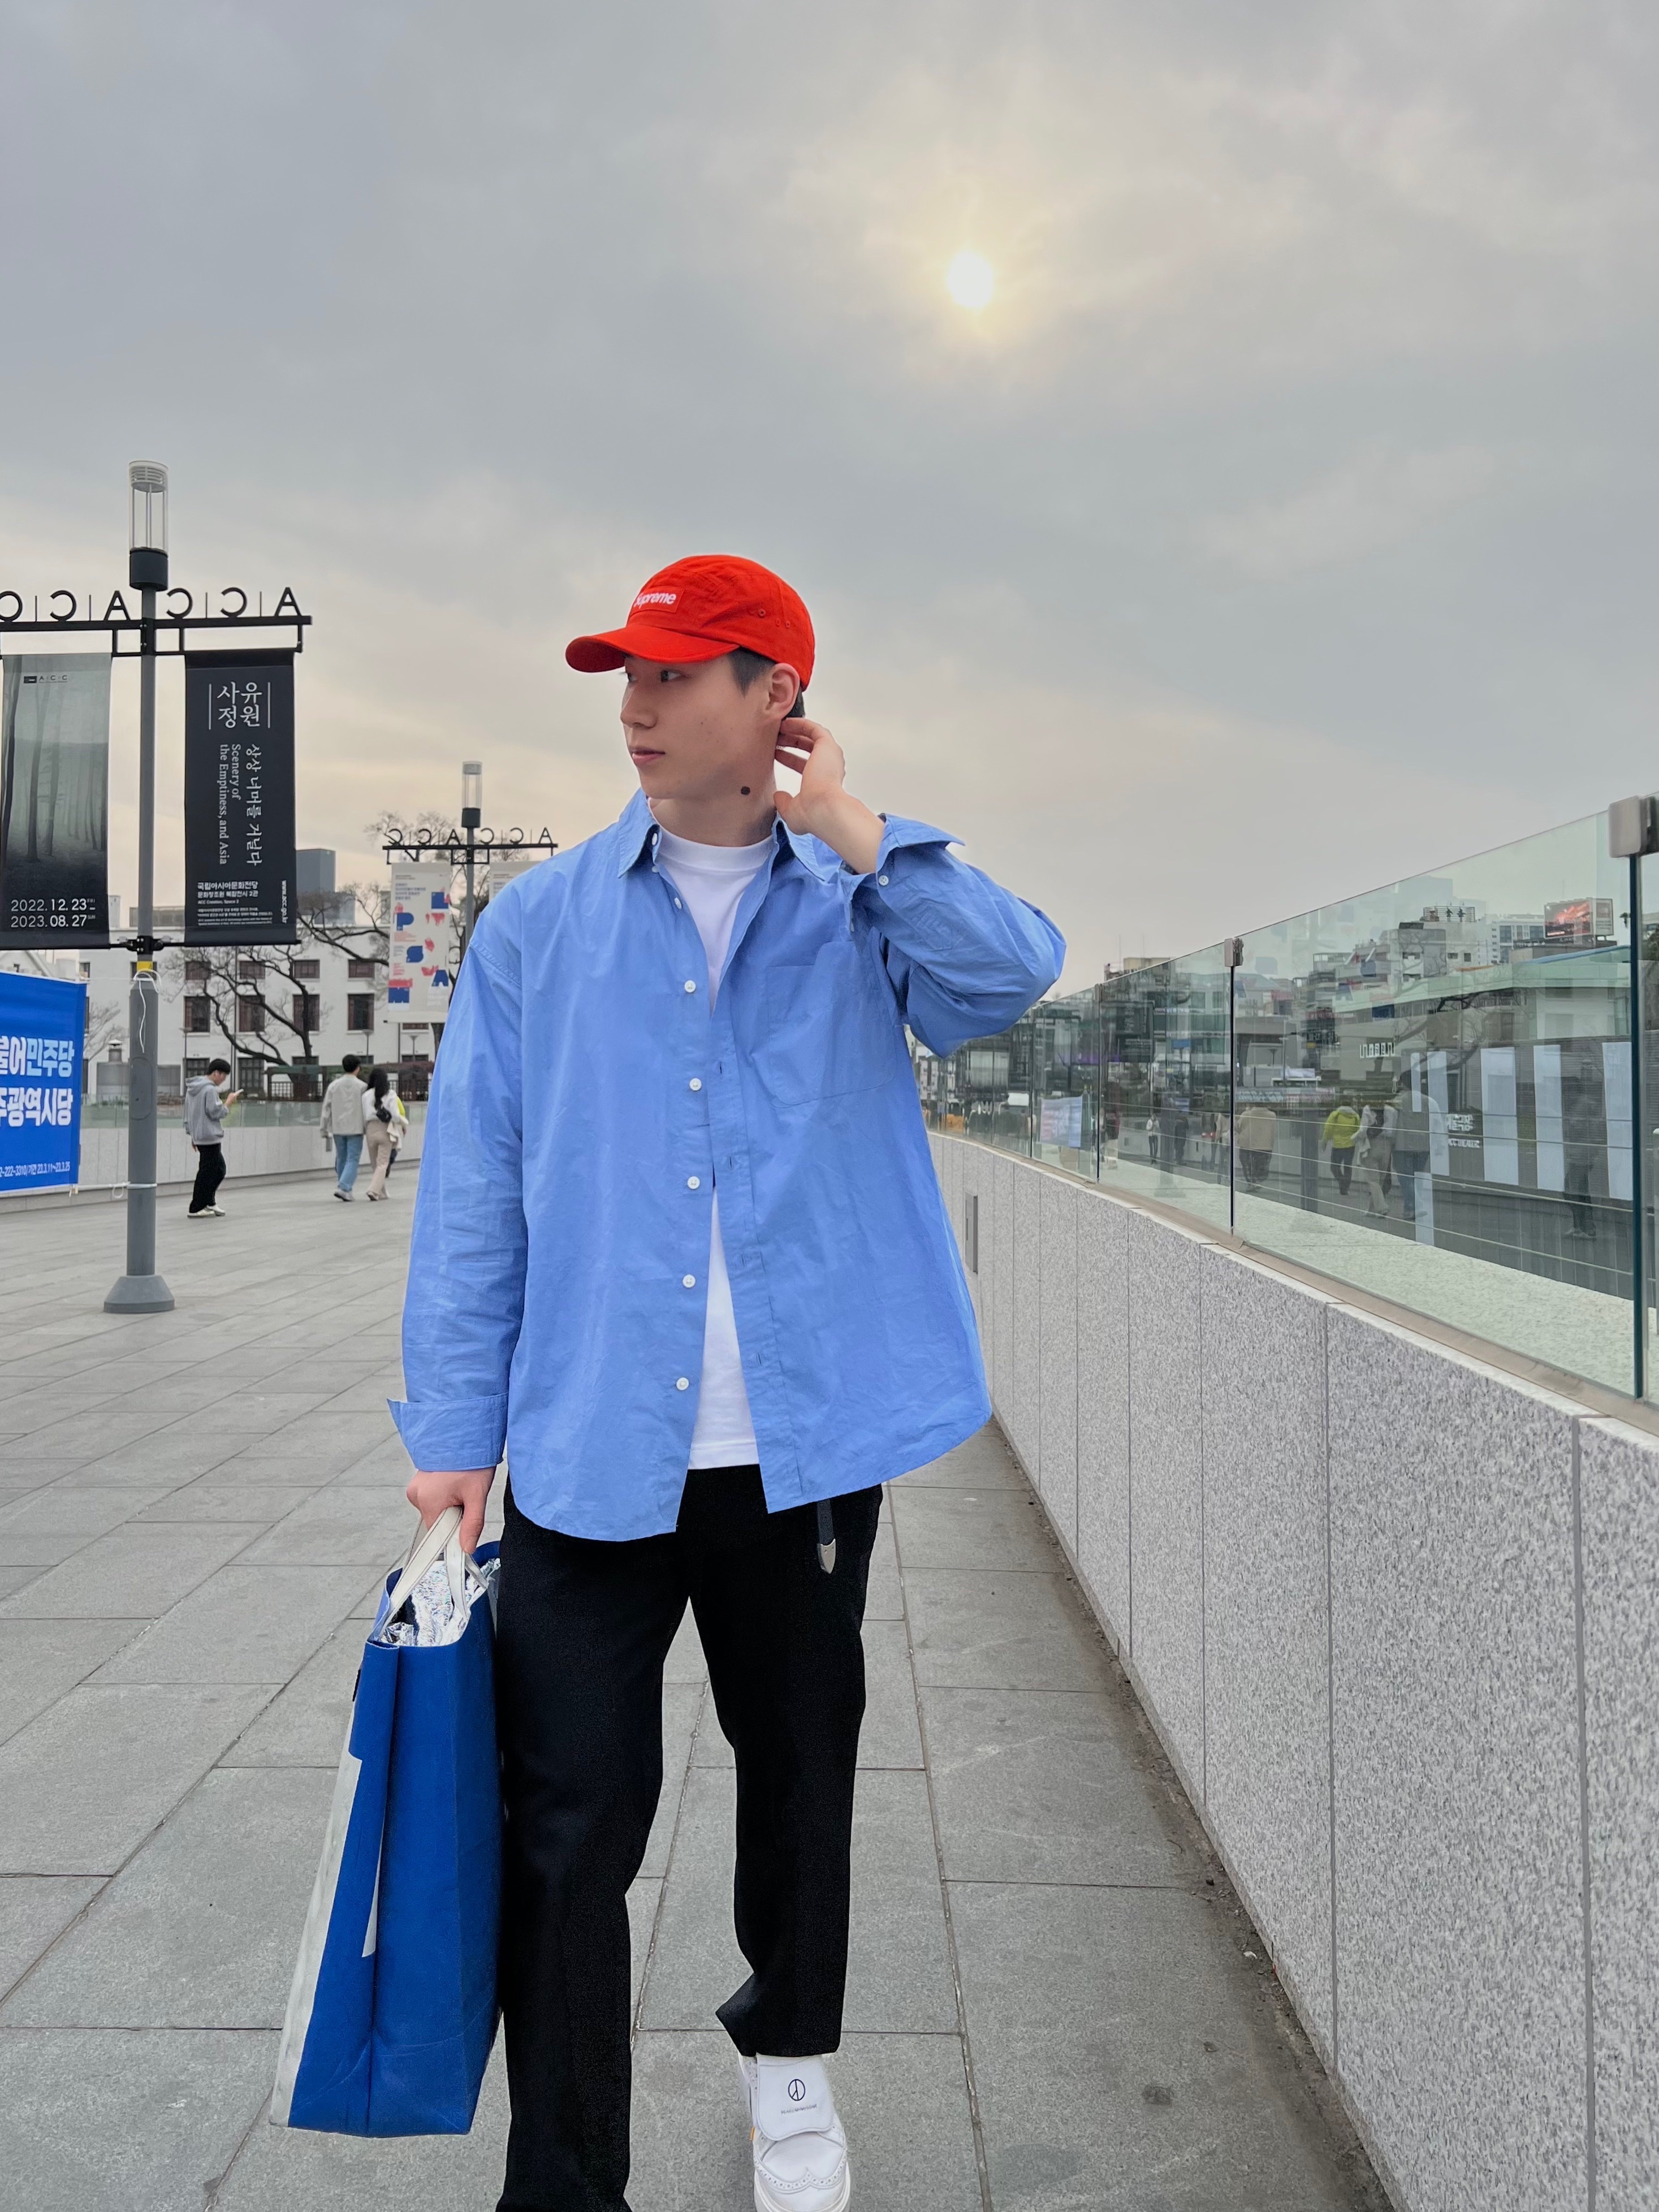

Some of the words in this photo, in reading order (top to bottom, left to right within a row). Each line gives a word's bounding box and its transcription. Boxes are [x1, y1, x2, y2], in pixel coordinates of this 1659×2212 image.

[220, 744, 230, 761] the
[246, 744, 262, 772] 상상
[229, 744, 241, 787] Scenery
[217, 763, 230, 819] Emptiness,
[232, 788, 241, 800] of
[246, 776, 262, 819] 너머를
[219, 820, 230, 839] and
[219, 842, 230, 865] Asia
[246, 823, 262, 866] 거닐다
[197, 881, 258, 891] 국립아시아문화전당
